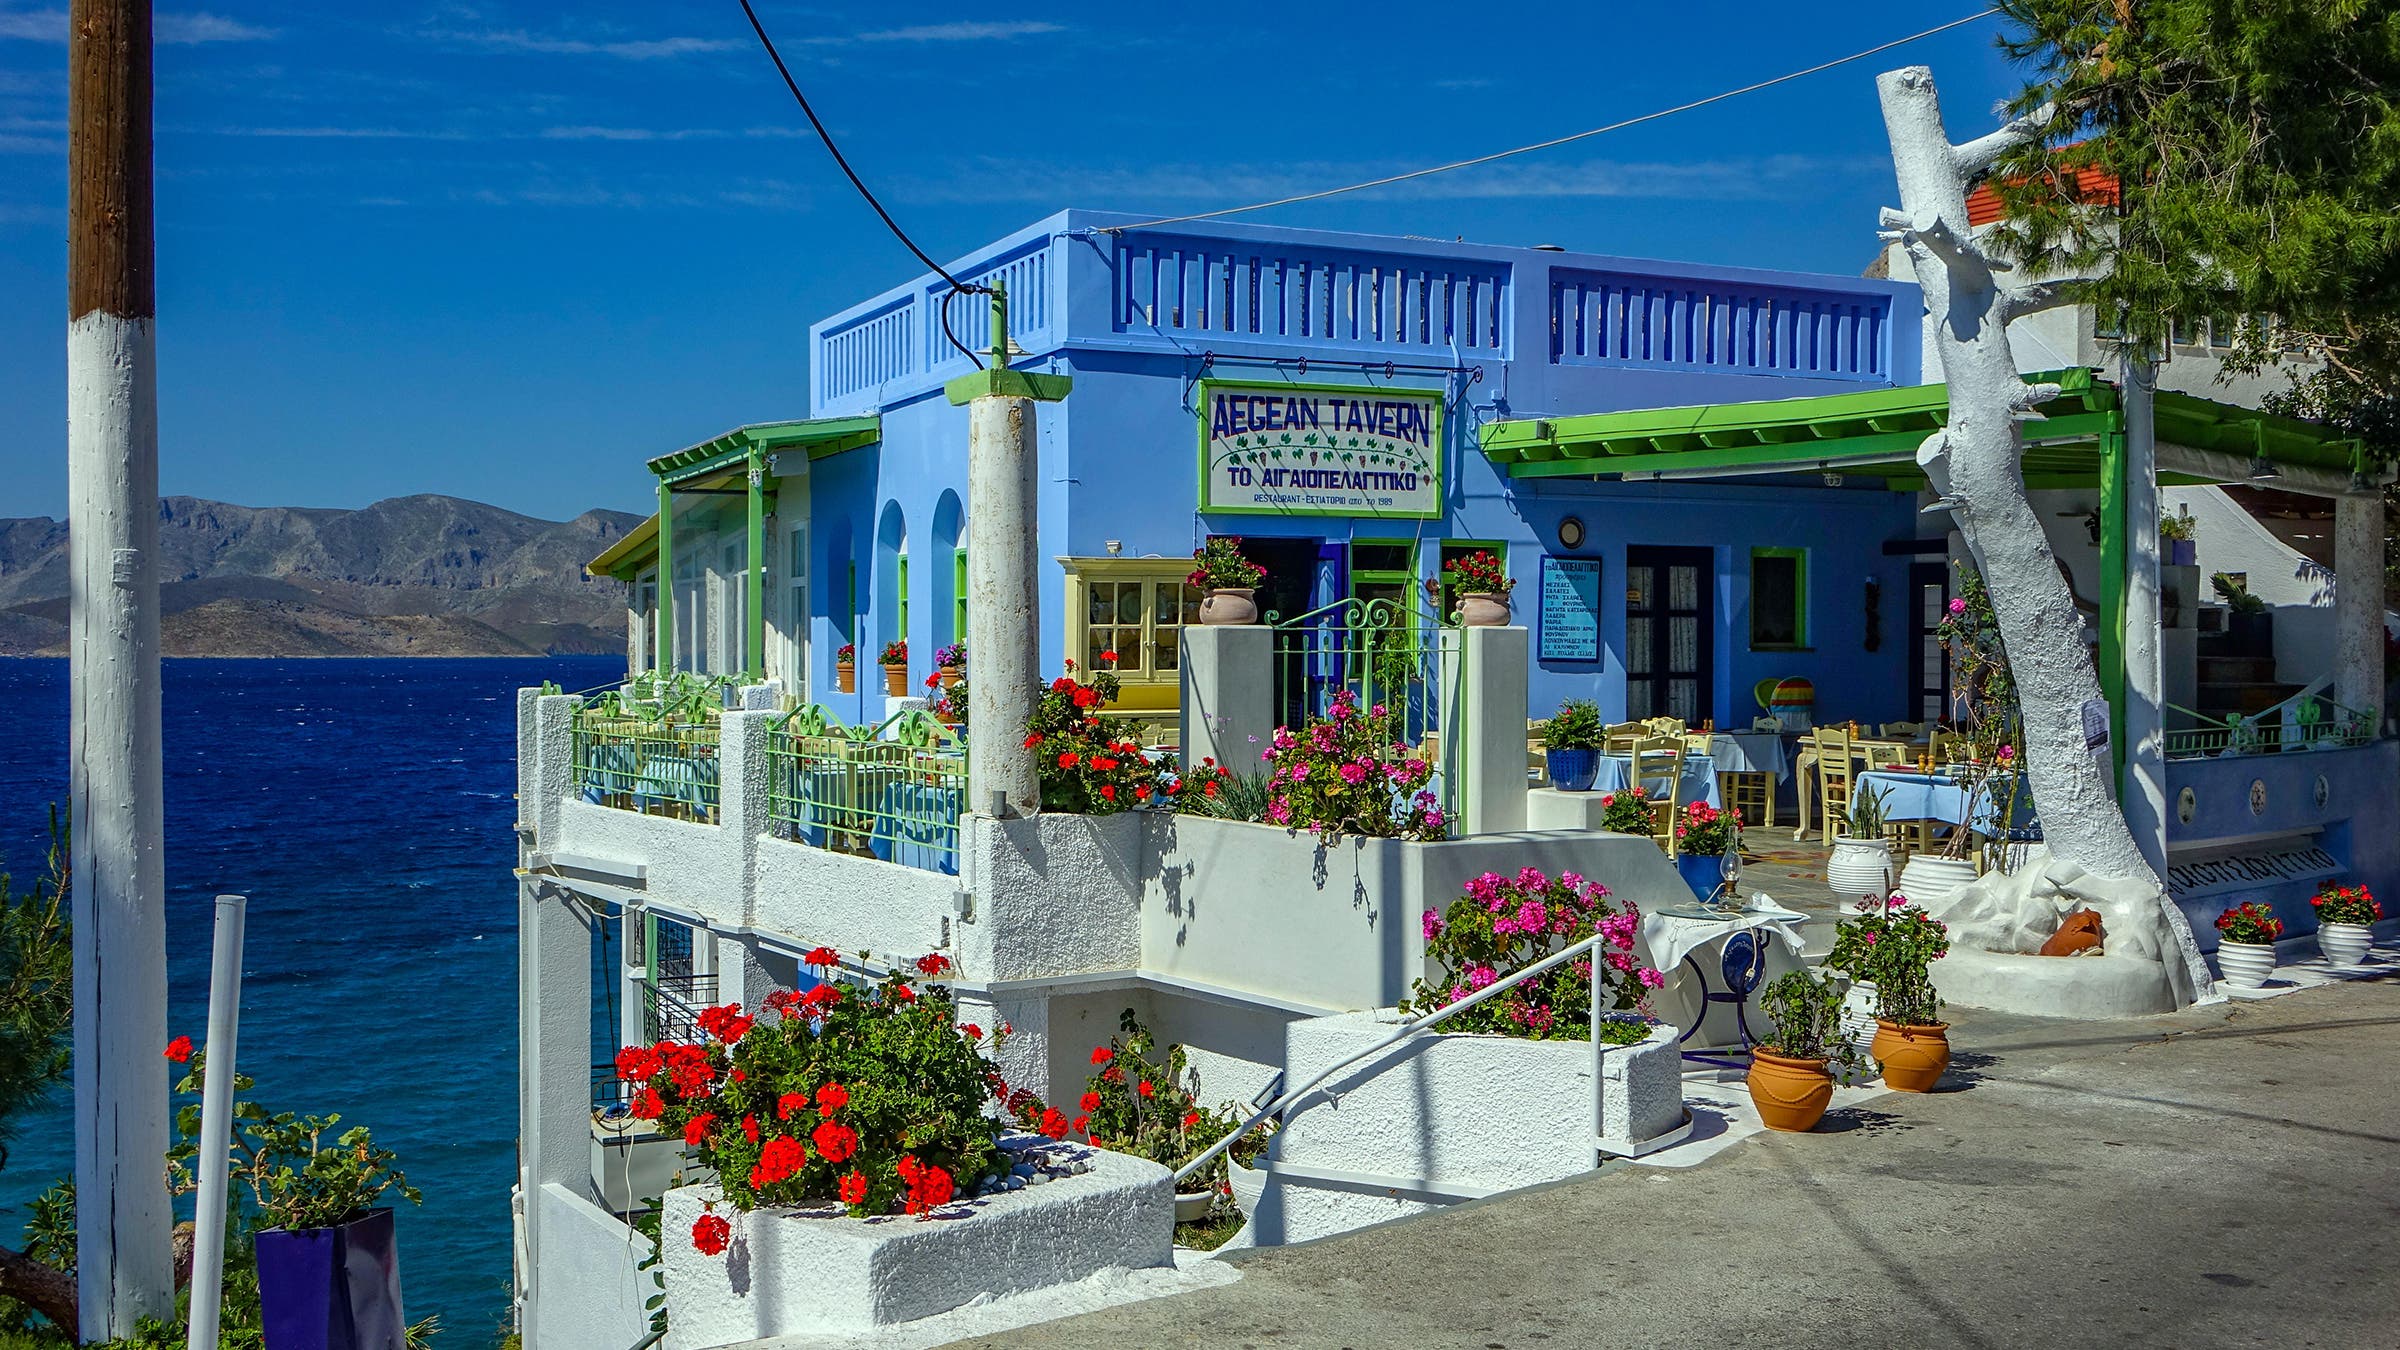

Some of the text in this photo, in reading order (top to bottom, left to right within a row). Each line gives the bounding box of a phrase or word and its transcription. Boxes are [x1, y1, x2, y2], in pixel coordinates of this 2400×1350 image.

[1211, 394, 1430, 447] AEGEAN TAVERN
[1227, 467, 1417, 491] ΤΟ ΑΙΓΑΙΟΠΕΛΑΓΙΤΙΚΟ
[1378, 497, 1393, 506] 1989
